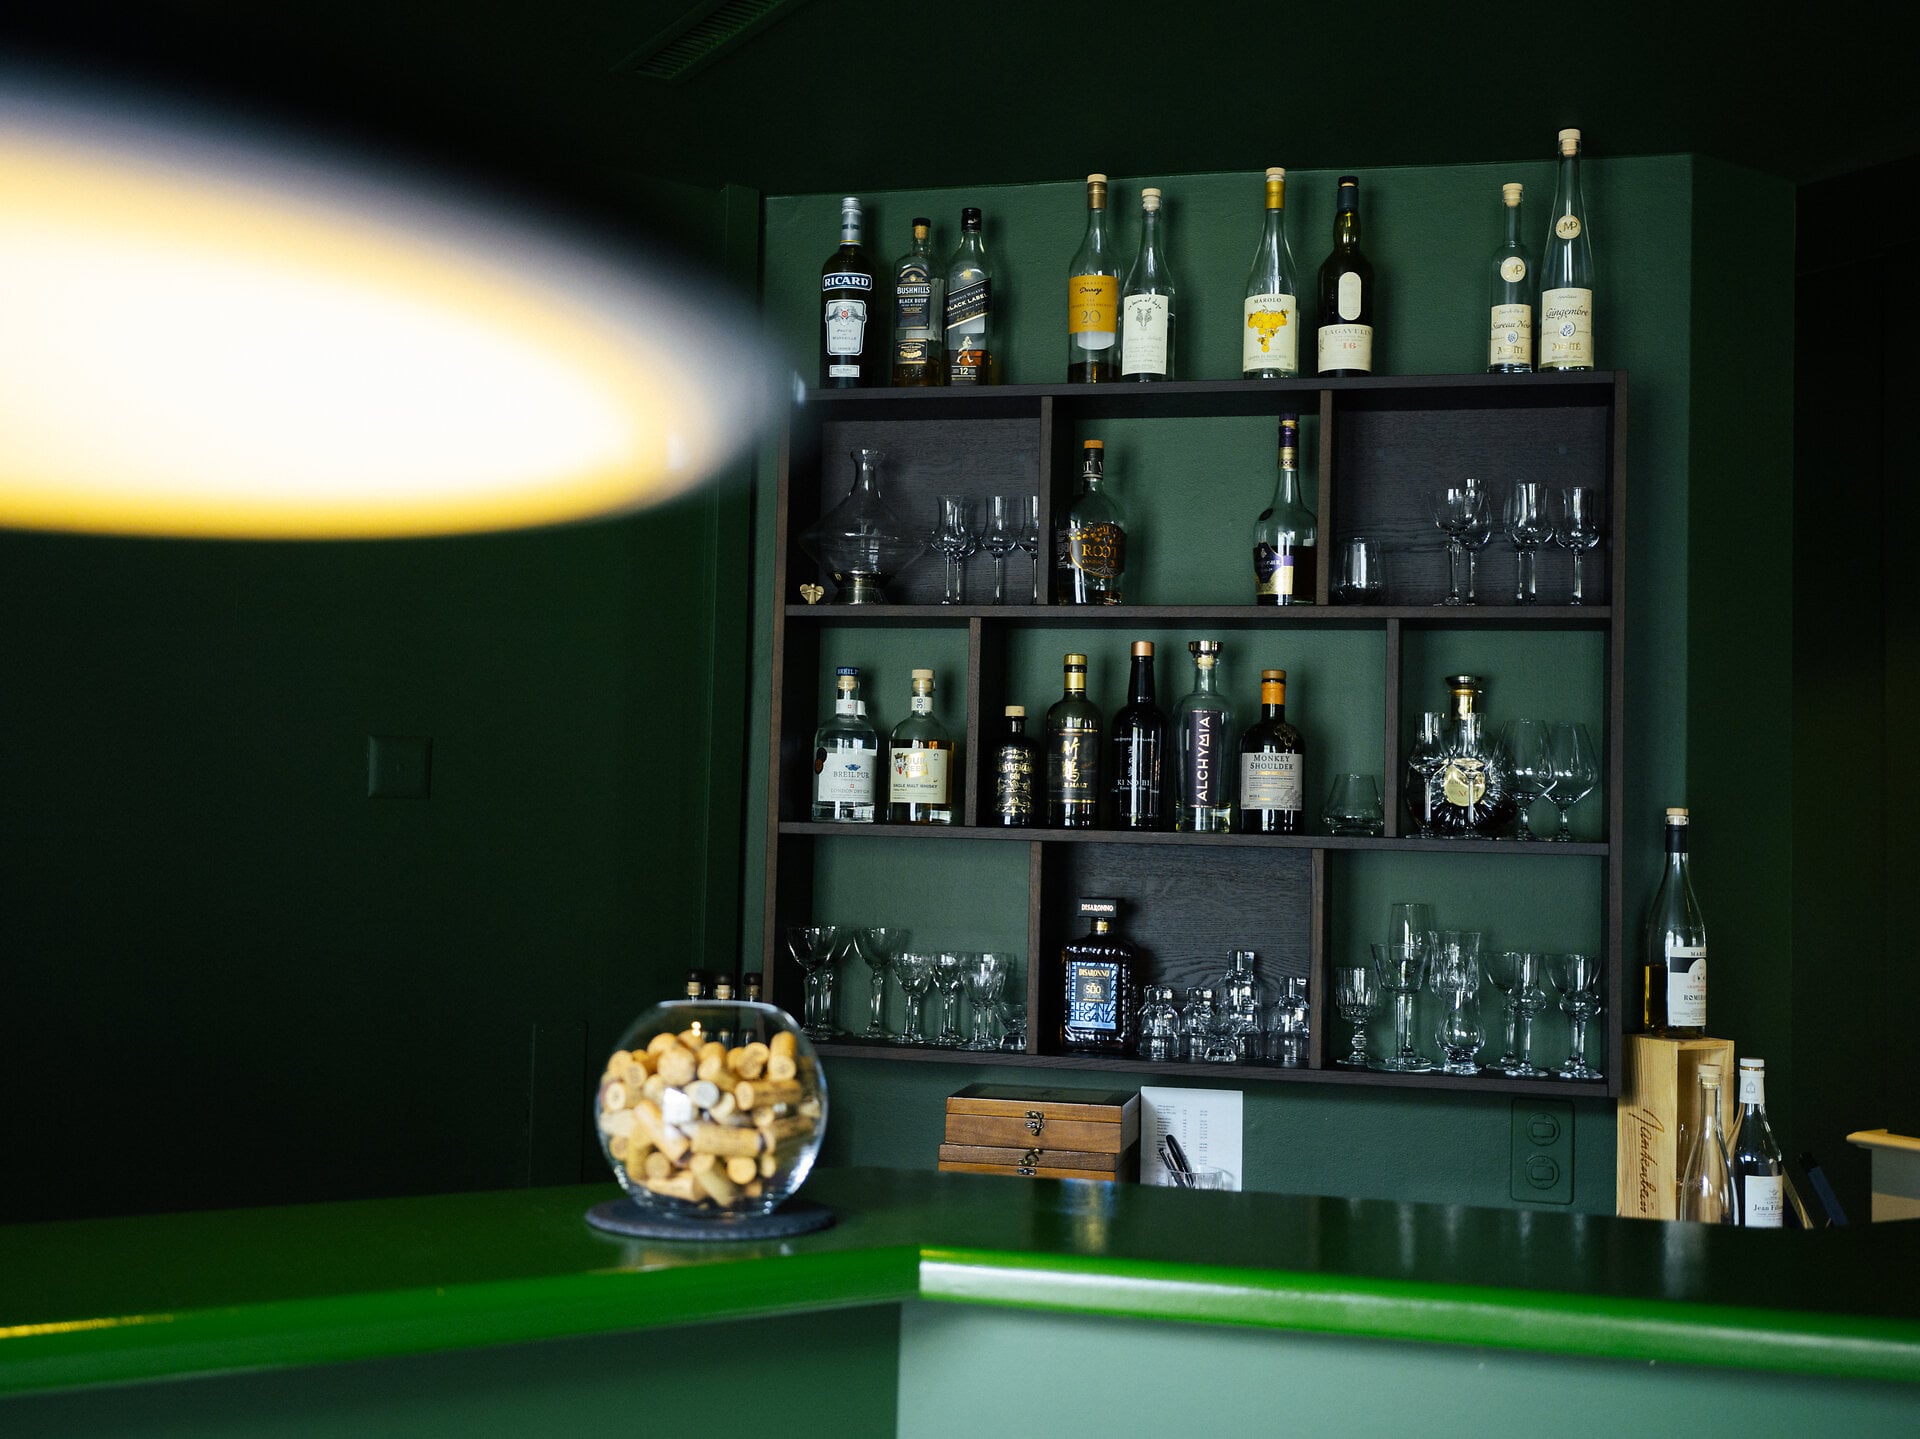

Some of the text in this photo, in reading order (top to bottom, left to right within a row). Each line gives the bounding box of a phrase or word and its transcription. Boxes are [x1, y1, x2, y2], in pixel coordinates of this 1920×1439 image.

[824, 276, 869, 287] RICARD
[897, 286, 931, 295] BUSHMILLS
[1080, 309, 1101, 324] 20
[1342, 342, 1357, 350] 16
[959, 367, 969, 376] 12
[1196, 716, 1211, 802] ALCHYMIA
[1253, 754, 1290, 763] MONKEY
[1250, 762, 1294, 770] SHOULDER
[1081, 903, 1114, 912] DISARONNO
[1078, 967, 1110, 977] DISARONNO
